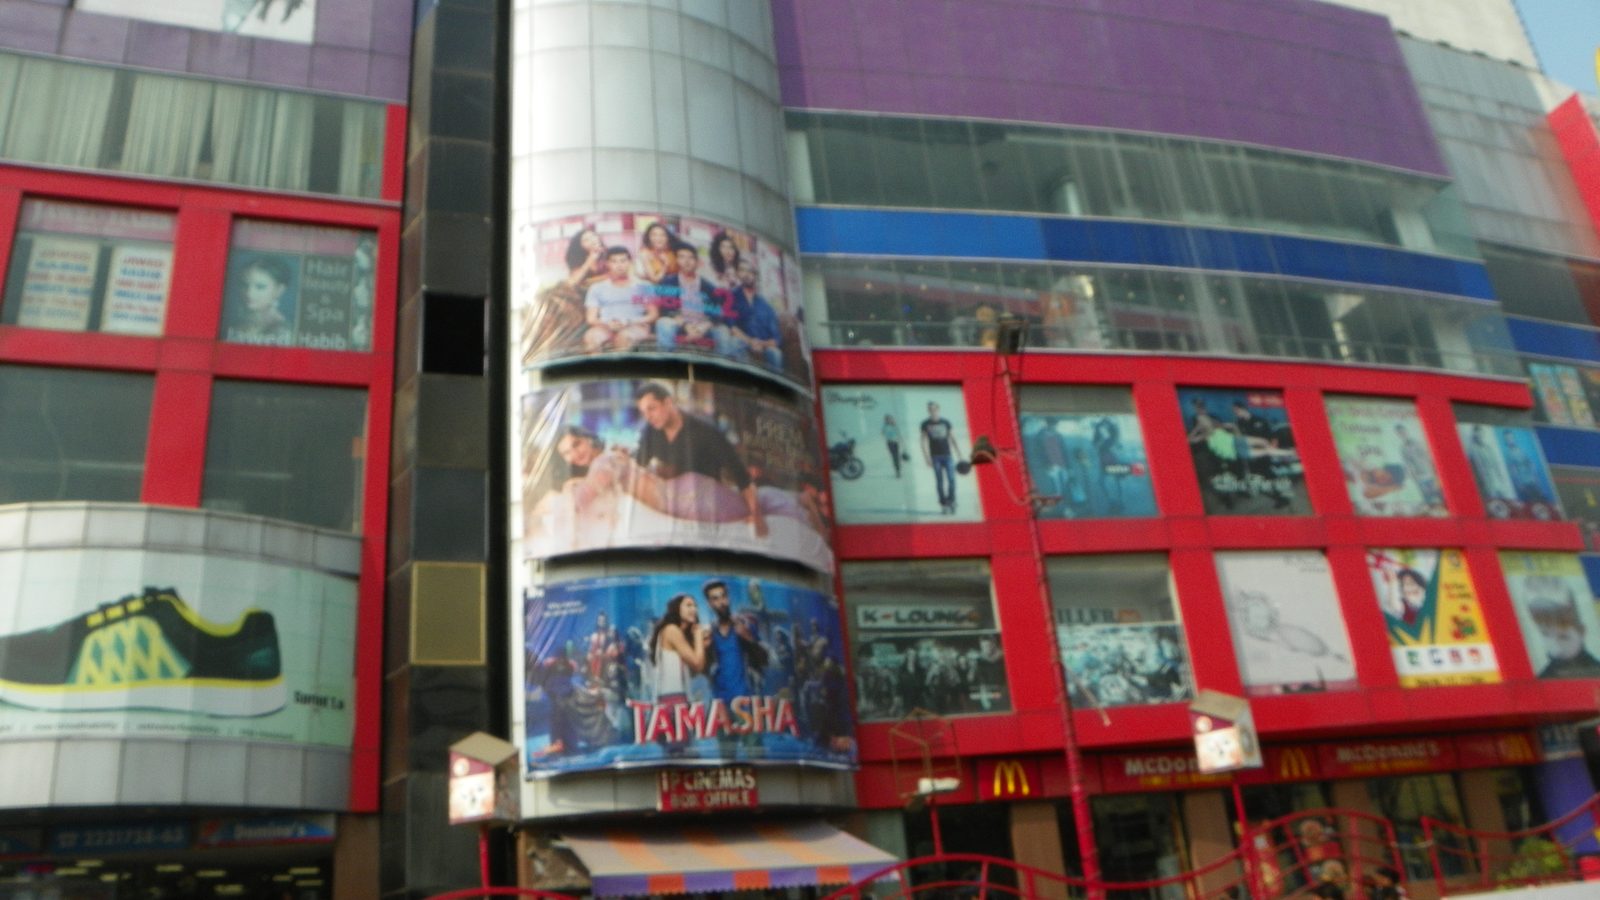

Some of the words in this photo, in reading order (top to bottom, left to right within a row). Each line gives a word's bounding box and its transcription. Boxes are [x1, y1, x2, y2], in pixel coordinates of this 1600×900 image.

[306, 303, 345, 322] Spa
[712, 288, 738, 318] 2
[299, 333, 346, 351] Habib
[625, 695, 800, 745] TAMASHA
